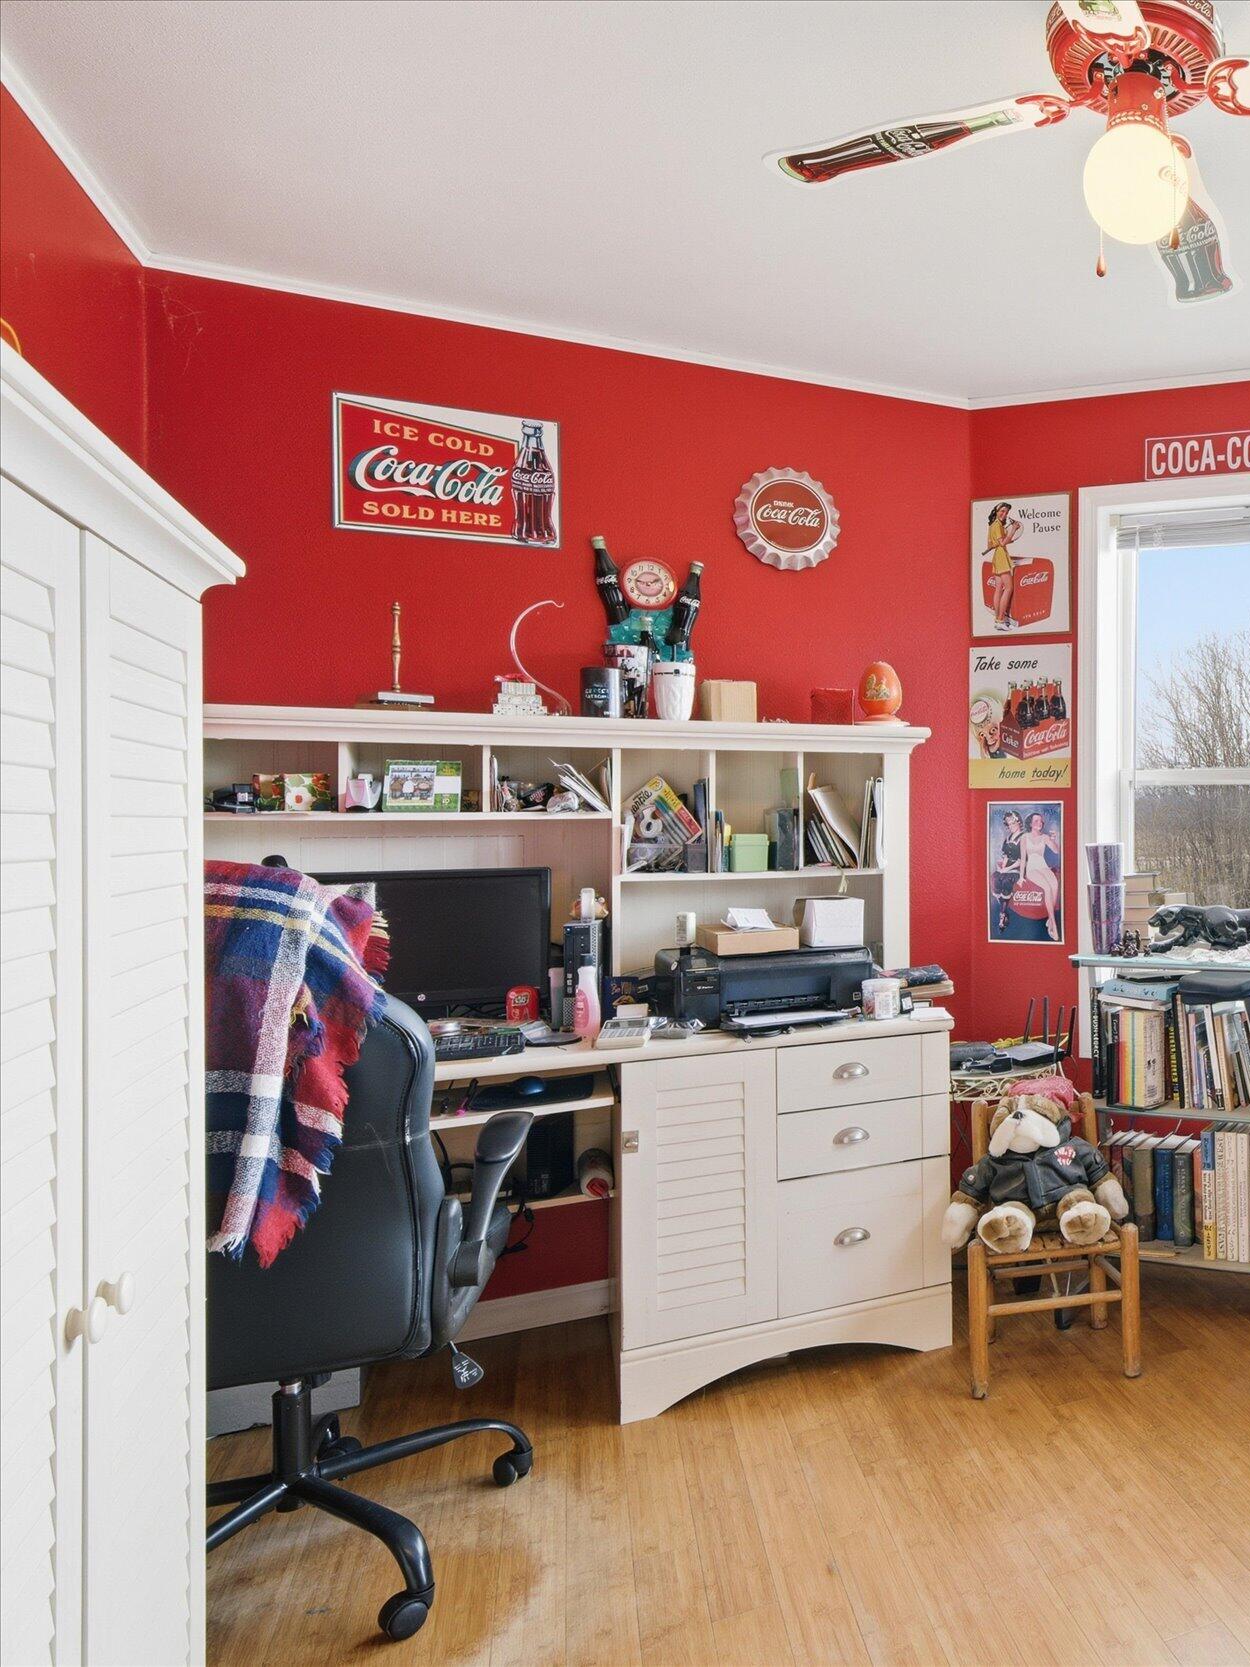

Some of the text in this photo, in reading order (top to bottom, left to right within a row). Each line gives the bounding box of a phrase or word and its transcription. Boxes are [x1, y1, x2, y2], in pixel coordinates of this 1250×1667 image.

[373, 419, 494, 457] ICE COLD
[352, 445, 508, 506] Coca-Cola
[362, 501, 503, 527] SOLD HERE
[1018, 509, 1061, 520] Welcome
[1033, 523, 1061, 533] Pause
[974, 656, 1038, 672] Take some
[999, 765, 1068, 782] home today!
